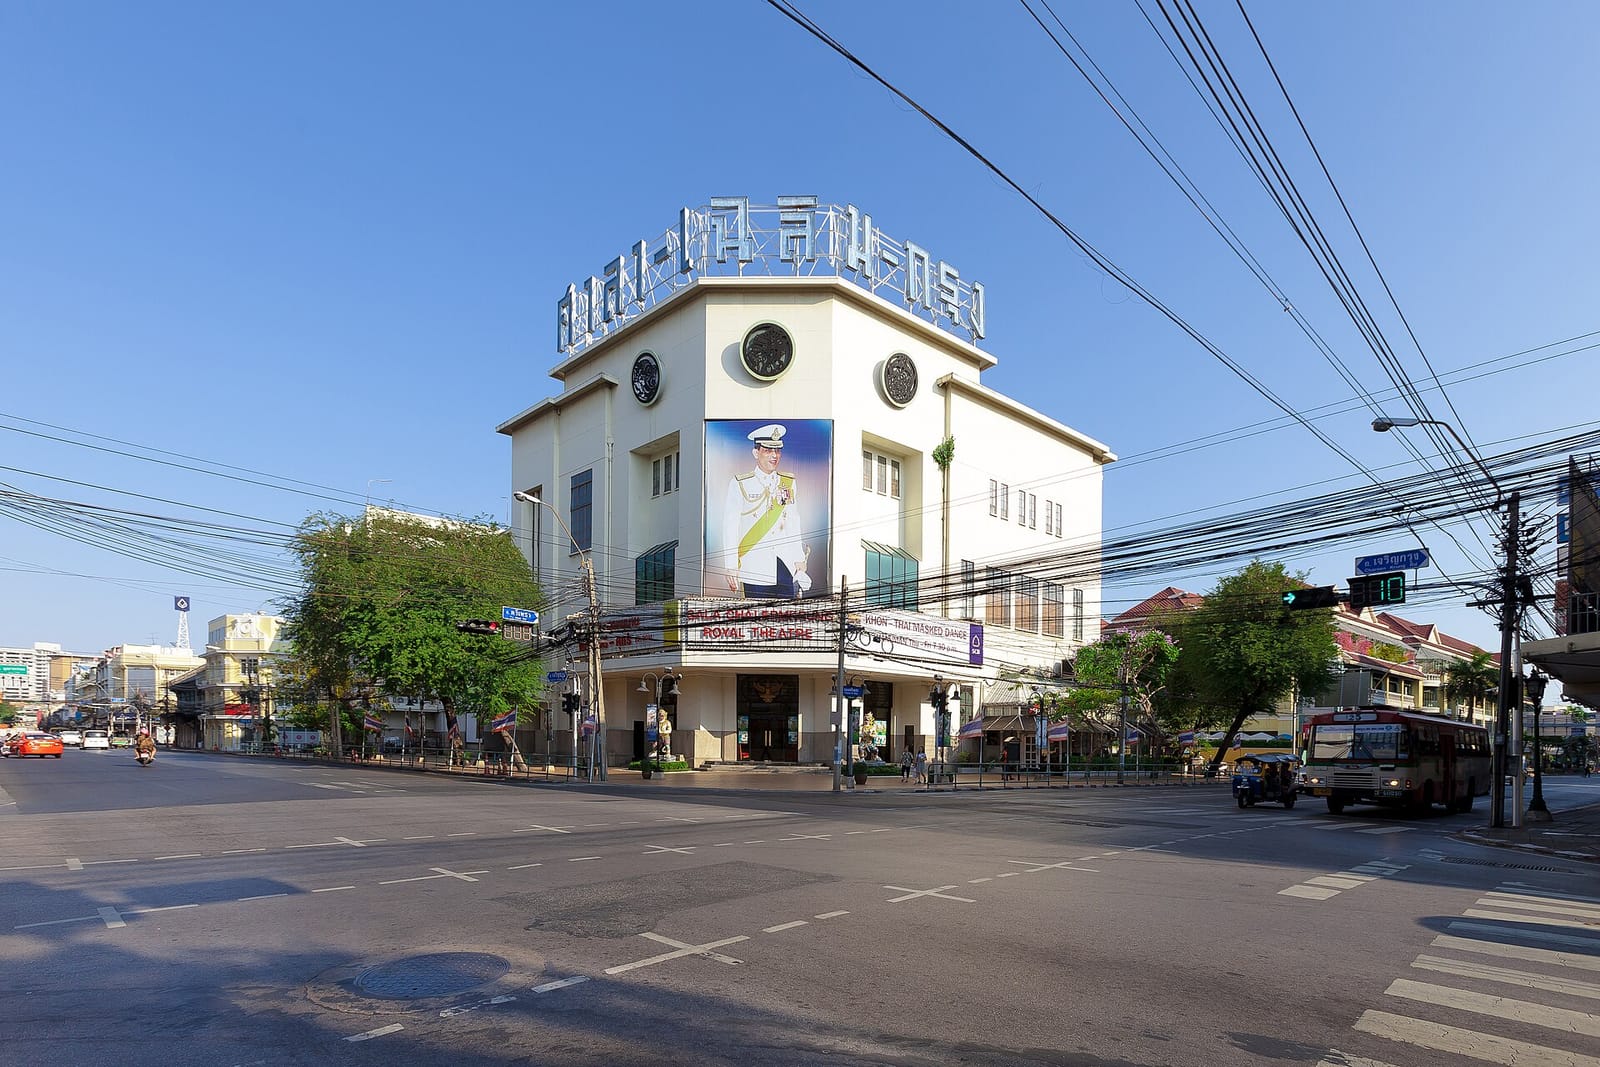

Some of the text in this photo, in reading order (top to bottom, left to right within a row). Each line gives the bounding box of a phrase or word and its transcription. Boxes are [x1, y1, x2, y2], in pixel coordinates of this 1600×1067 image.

[1380, 577, 1403, 601] 10
[703, 627, 813, 640] ROYAL THEATRE
[865, 614, 888, 627] KHON
[894, 618, 911, 631] THAI
[912, 621, 943, 635] MASKED
